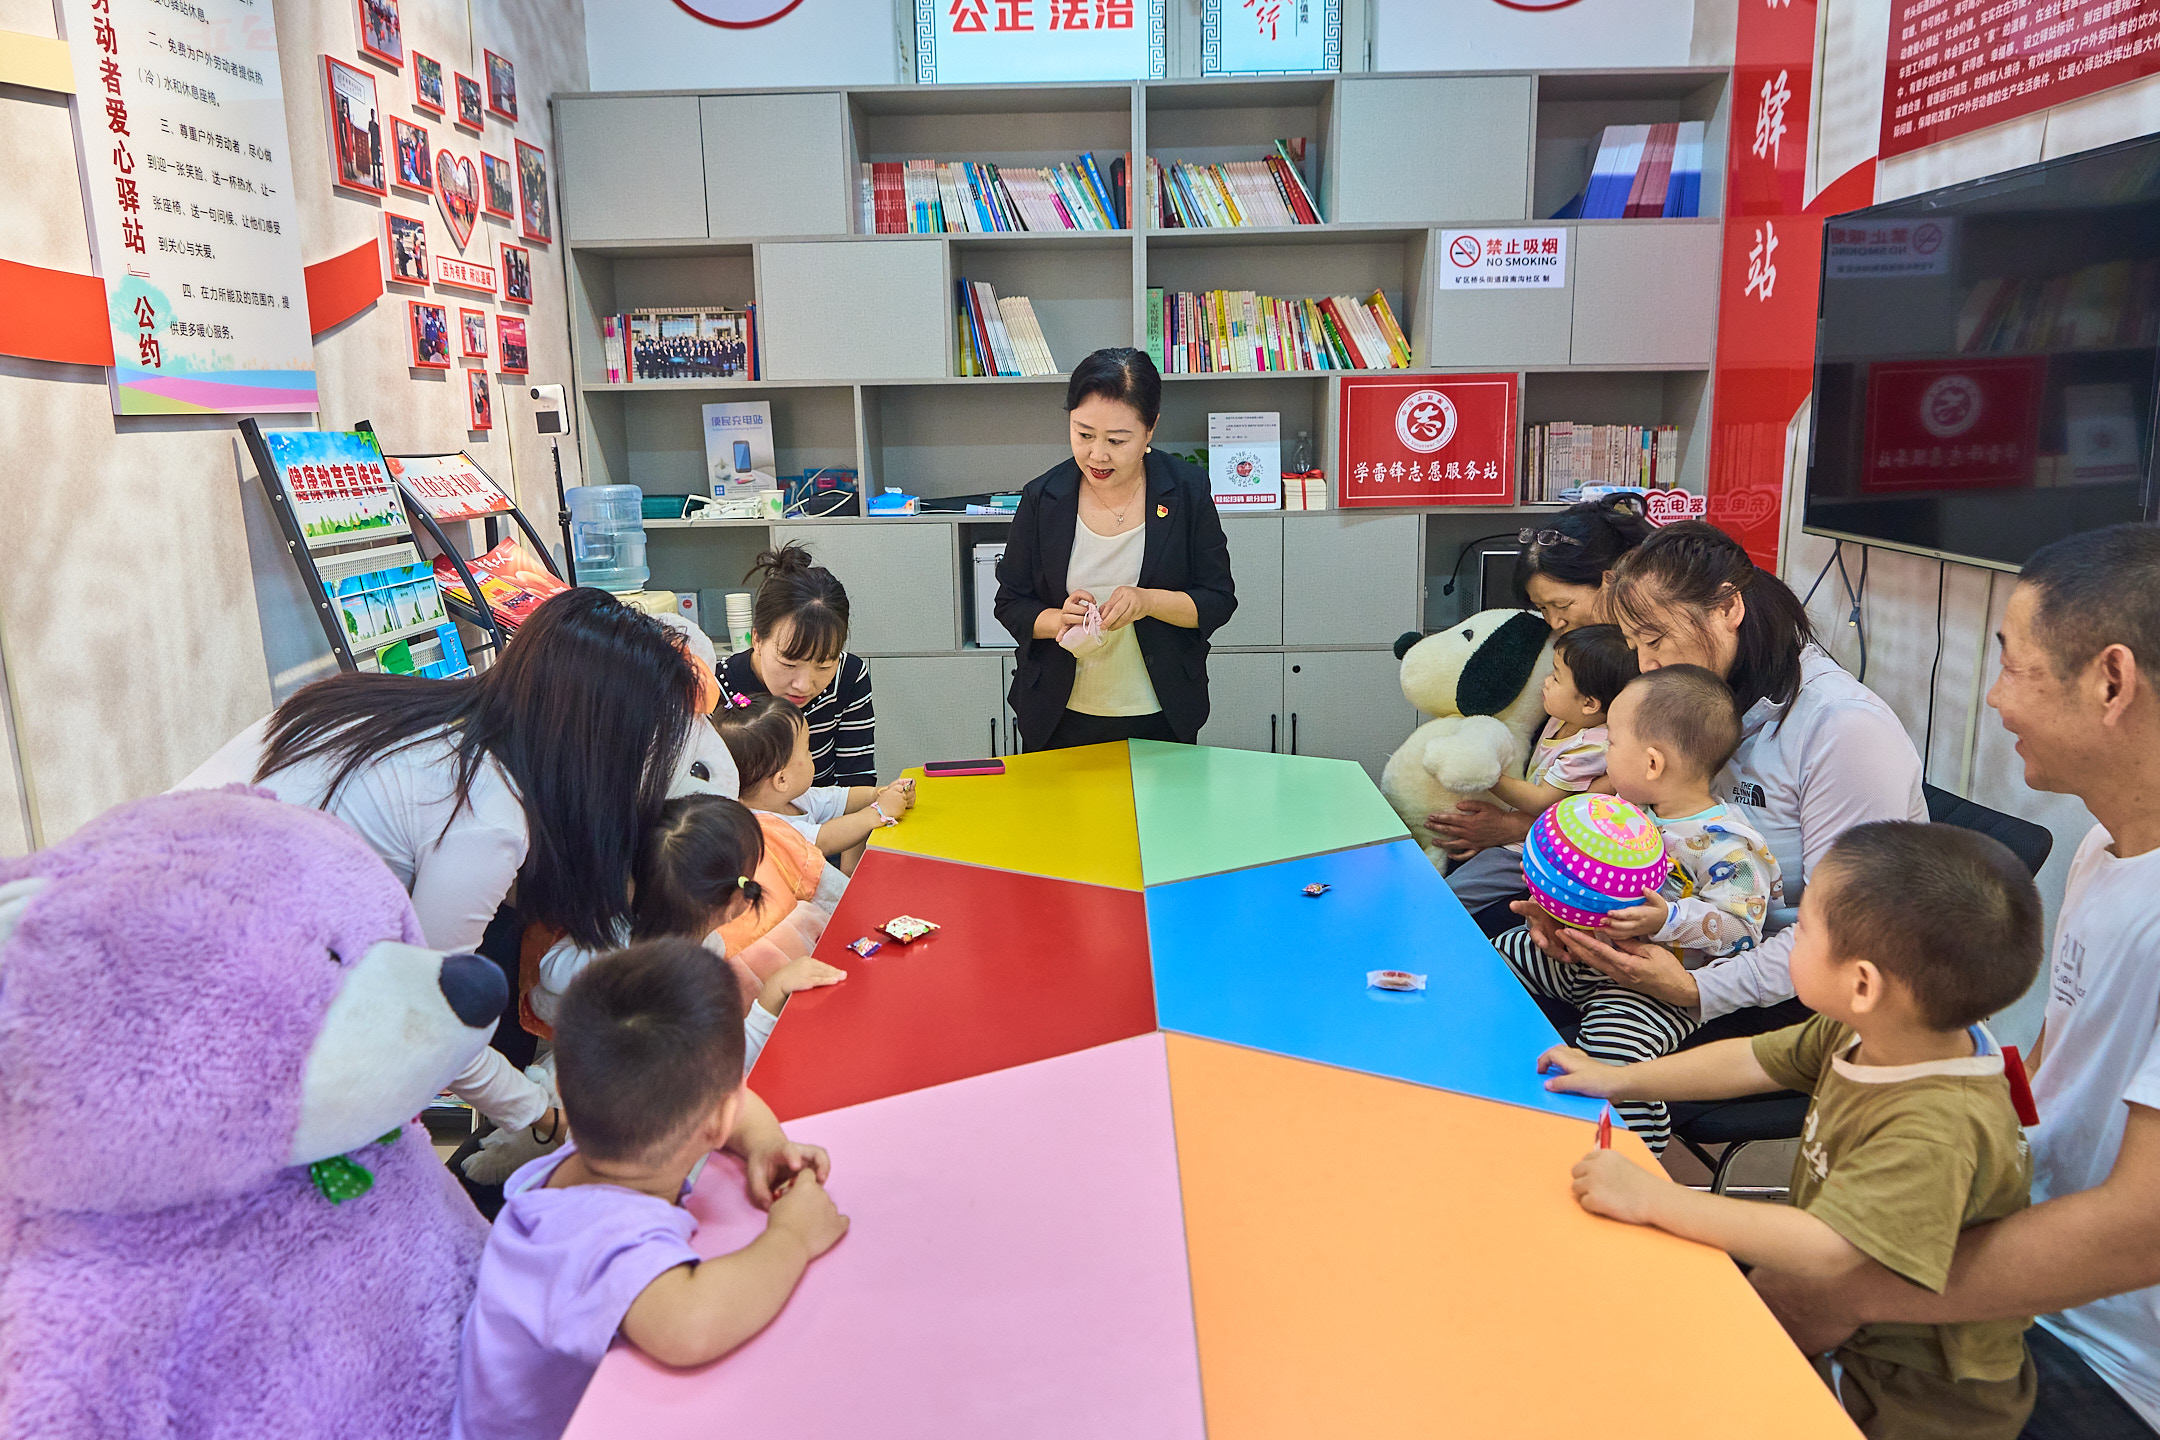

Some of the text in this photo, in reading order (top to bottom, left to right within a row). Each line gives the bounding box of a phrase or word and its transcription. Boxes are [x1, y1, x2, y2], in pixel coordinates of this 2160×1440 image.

[949, 0, 1134, 32] 公正 法治
[1743, 0, 1791, 303] 驿站
[1486, 238, 1558, 255] 禁止吸烟
[1486, 257, 1557, 267] NO SMOKING
[711, 414, 763, 427] 便民充电站
[286, 461, 388, 501] 健康教育宣传栏
[1353, 460, 1499, 484] 学雷锋志愿服务站
[407, 472, 489, 498] 红色读书吧
[1652, 498, 1704, 514] 充电器
[1741, 781, 1754, 790] THE
